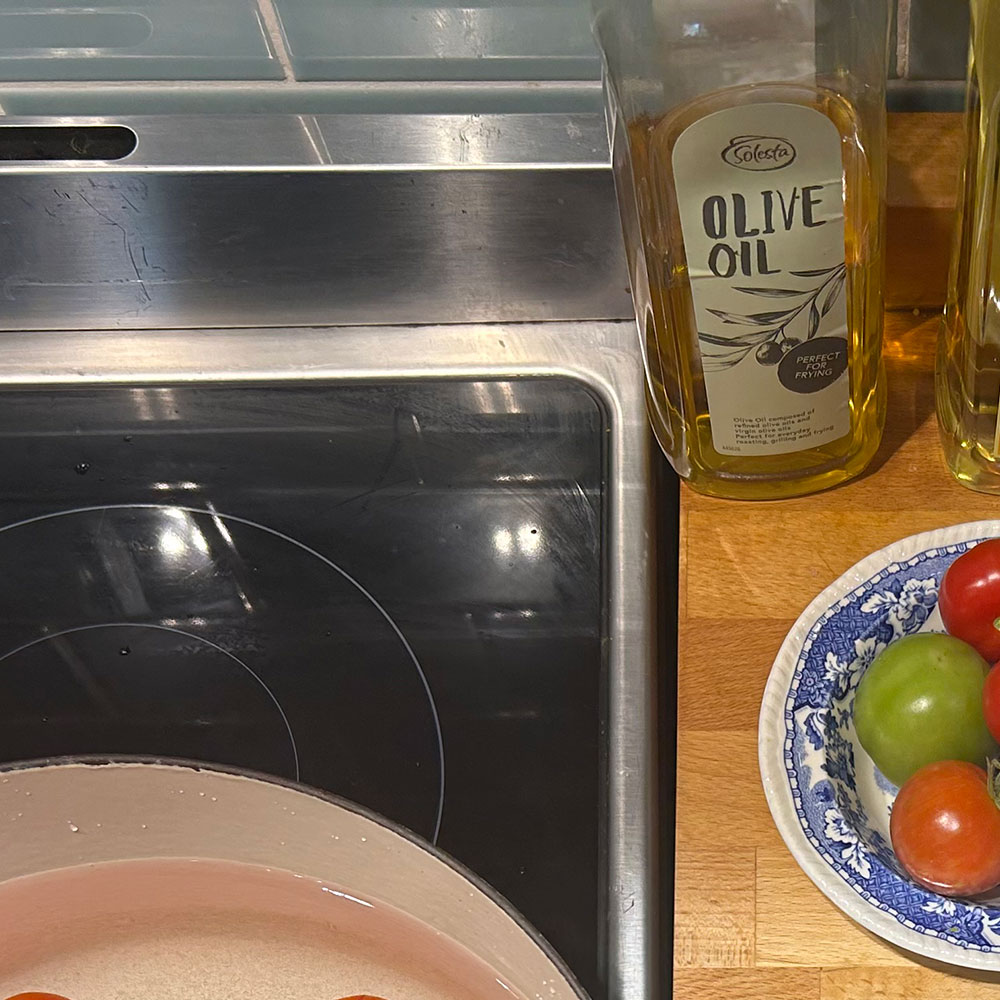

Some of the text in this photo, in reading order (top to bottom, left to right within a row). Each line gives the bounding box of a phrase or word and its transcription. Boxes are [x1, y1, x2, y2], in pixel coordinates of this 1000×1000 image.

[702, 185, 827, 239] OLIVE
[708, 240, 781, 278] OIL
[796, 352, 840, 364] PERFECT
[806, 362, 827, 370] FOR
[795, 368, 832, 378] FRYING
